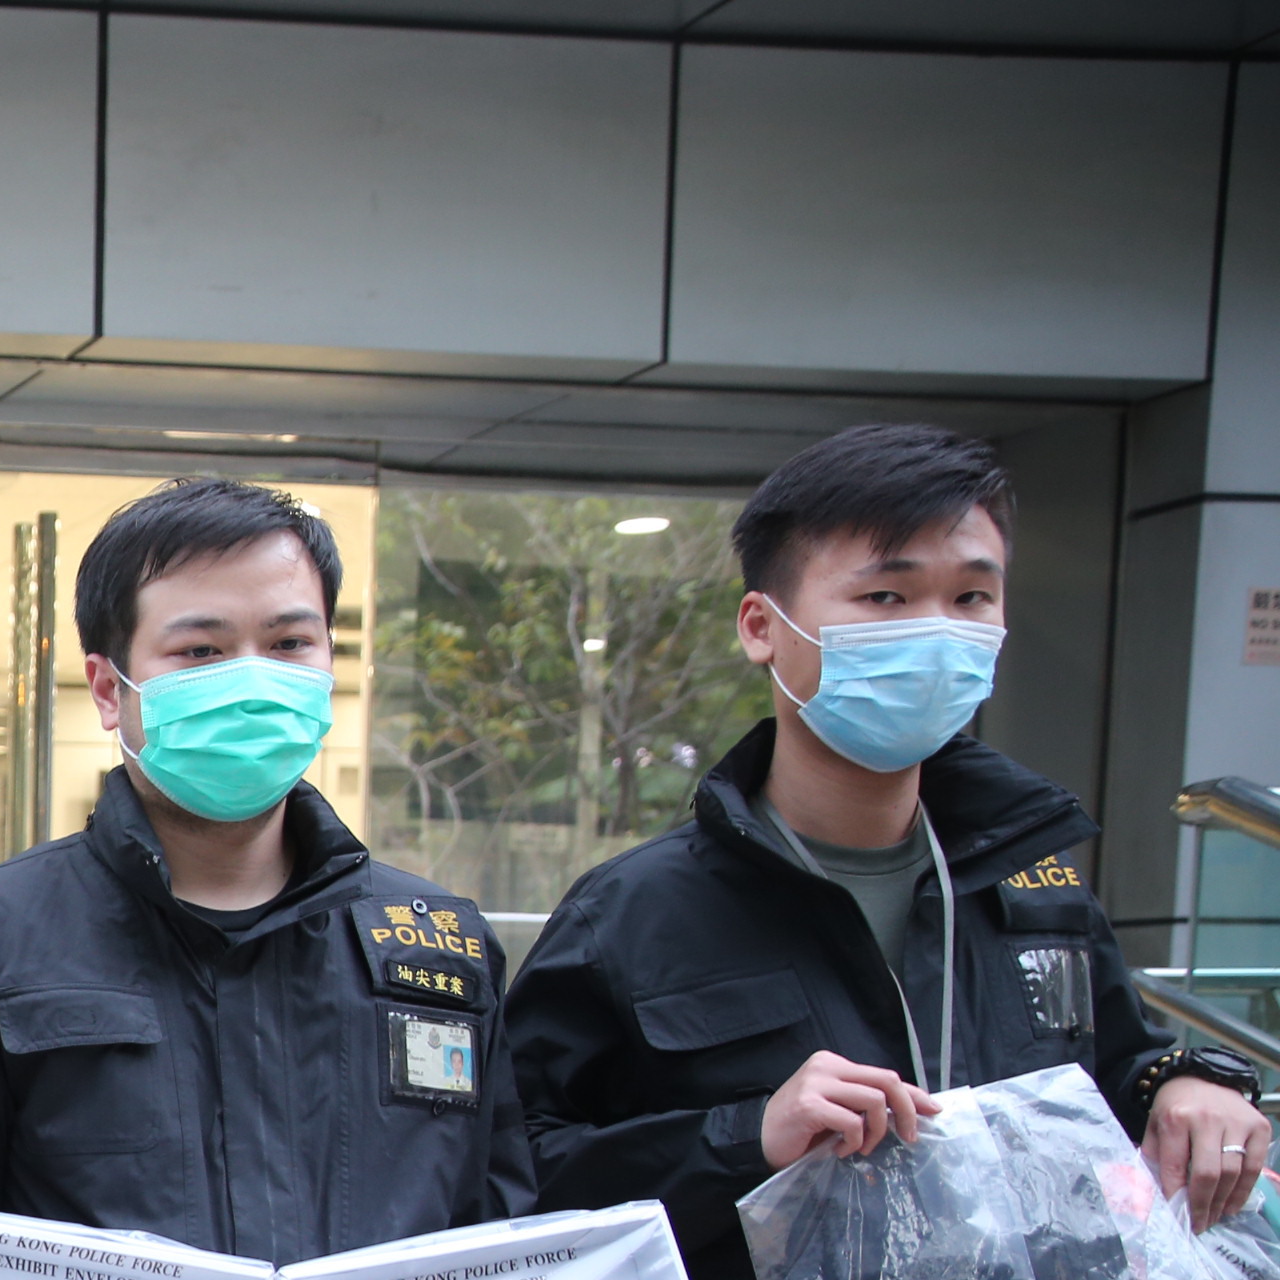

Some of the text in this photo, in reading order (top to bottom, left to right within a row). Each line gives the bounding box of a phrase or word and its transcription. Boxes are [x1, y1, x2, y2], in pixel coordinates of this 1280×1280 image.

[1001, 867, 1080, 889] OLICE
[384, 905, 460, 934] 警察
[371, 926, 482, 959] POLICE
[397, 964, 464, 996] 油尖重案
[16, 1236, 63, 1255] KONG
[69, 1246, 126, 1267] POLICE
[132, 1257, 183, 1278] FORCE
[464, 1258, 519, 1280] POLICE
[525, 1247, 577, 1268] FORCE
